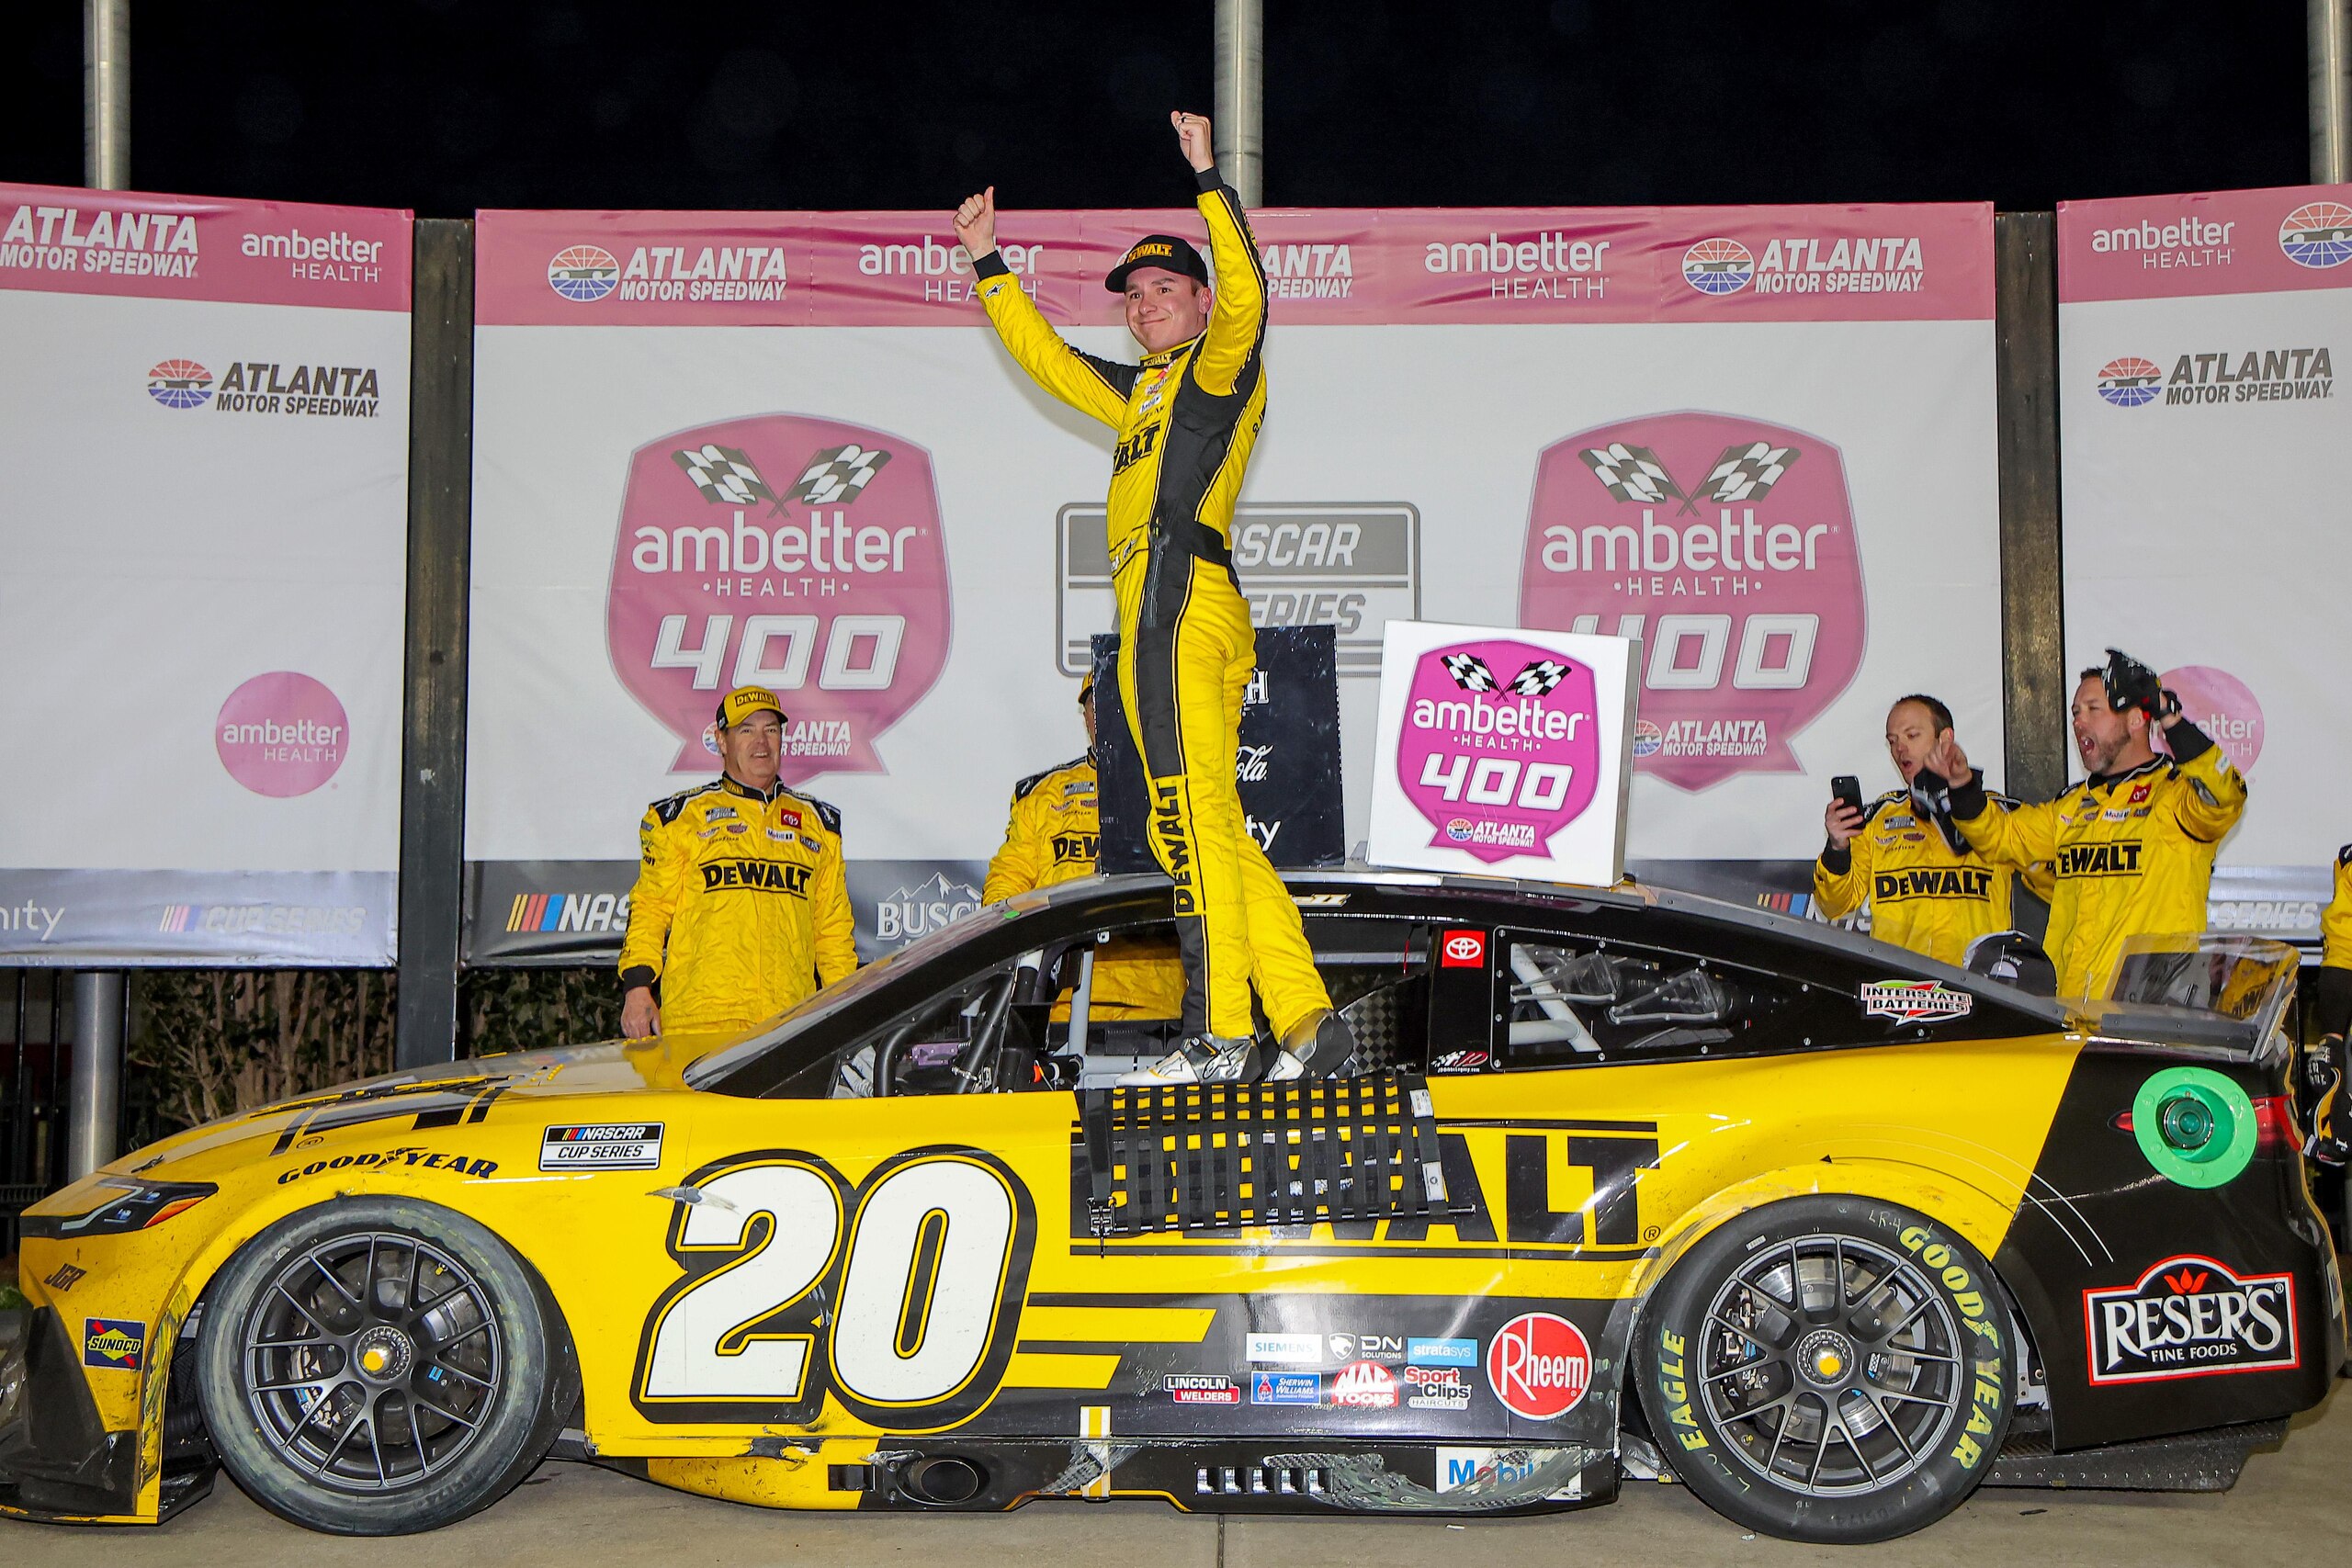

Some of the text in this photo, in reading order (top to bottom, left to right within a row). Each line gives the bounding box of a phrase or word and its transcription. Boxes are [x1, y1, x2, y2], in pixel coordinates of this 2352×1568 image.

[3, 205, 198, 254] ATLANTA
[2091, 217, 2235, 253] ambetter
[241, 229, 384, 264] ambetter
[858, 235, 1044, 276] ambeer
[1424, 231, 1610, 274] ambetter
[1756, 238, 1924, 272] ATLANTA
[2143, 248, 2232, 269] HEALTH
[0, 243, 198, 278] MOTOR SPEEDWAY
[623, 245, 787, 282] ATLANTA
[292, 263, 380, 284] HEALTH
[1754, 270, 1924, 294] MOTOR SPEEDWAY
[619, 278, 787, 302] MOTOR SPEEDWAY
[1267, 277, 1353, 299] PEEDWAY
[1491, 277, 1605, 299] HEALTH
[2167, 347, 2333, 386] ATLANTA
[219, 361, 379, 399] ATLANTA
[2165, 379, 2334, 406] MOTOR SPEEDWAY
[217, 393, 379, 418] MOTOR SPEEDWAY
[1114, 425, 1160, 472] ALT
[631, 510, 917, 574] ambetter
[1232, 522, 1363, 568] SCAR
[1542, 508, 1828, 572] ambetter
[716, 578, 836, 597] HEALTH
[1627, 576, 1749, 596] HEALTH
[1249, 593, 1367, 635] ERIES
[650, 614, 907, 691] 400
[1412, 694, 1583, 741] ambetter
[222, 718, 343, 746] ambetter
[781, 720, 852, 743] LANTA
[1461, 733, 1533, 753] HEALTH
[1666, 719, 1768, 744] ATLANTA
[264, 747, 337, 762] HEALTH
[790, 742, 852, 757] SPEEDWAY
[1662, 741, 1768, 757] MOTOR SPEEDWAY
[1419, 752, 1575, 811] 400
[1472, 835, 1535, 848] MOTOR SPEEDWAY
[1473, 820, 1536, 840] ATLANTA
[1051, 836, 1100, 862] DEW
[2057, 845, 2143, 874] EWALT
[700, 862, 812, 894] DEWALT
[1875, 871, 1993, 899] DEWALT
[558, 893, 632, 932] NAS
[2214, 901, 2319, 930] SERIES
[1866, 987, 1967, 1002] INTERSTATE
[1873, 999, 1966, 1011] BATTERIES
[582, 1126, 647, 1141] NASCAR
[558, 1145, 644, 1158] CUP SERIES
[277, 1146, 499, 1185] GOODYEAR
[44, 1263, 87, 1292] JGR
[639, 1154, 1020, 1408] 20
[2101, 1285, 2282, 1371] RESER'S
[90, 1336, 140, 1354] SUNOCO
[1255, 1342, 1314, 1353] SIEMENS
[1359, 1336, 1403, 1351] DN
[1361, 1351, 1402, 1359] SOLUTIONS
[1413, 1345, 1471, 1359] stratasys
[2151, 1342, 2238, 1363] FINE FOODS
[1501, 1317, 1585, 1402] Rheem
[1167, 1377, 1227, 1390] LINCOLN
[1278, 1377, 1314, 1387] SHERWIN
[1334, 1363, 1396, 1393] MAC
[1405, 1368, 1459, 1386] Sport
[1180, 1391, 1232, 1402] WELDERS
[1275, 1385, 1314, 1395] WILLIAMS
[1336, 1393, 1395, 1404] TOOLS
[1424, 1383, 1470, 1401] Clips
[1659, 1328, 1710, 1452] EAGLE
[1411, 1399, 1464, 1408] HAIRCUTS
